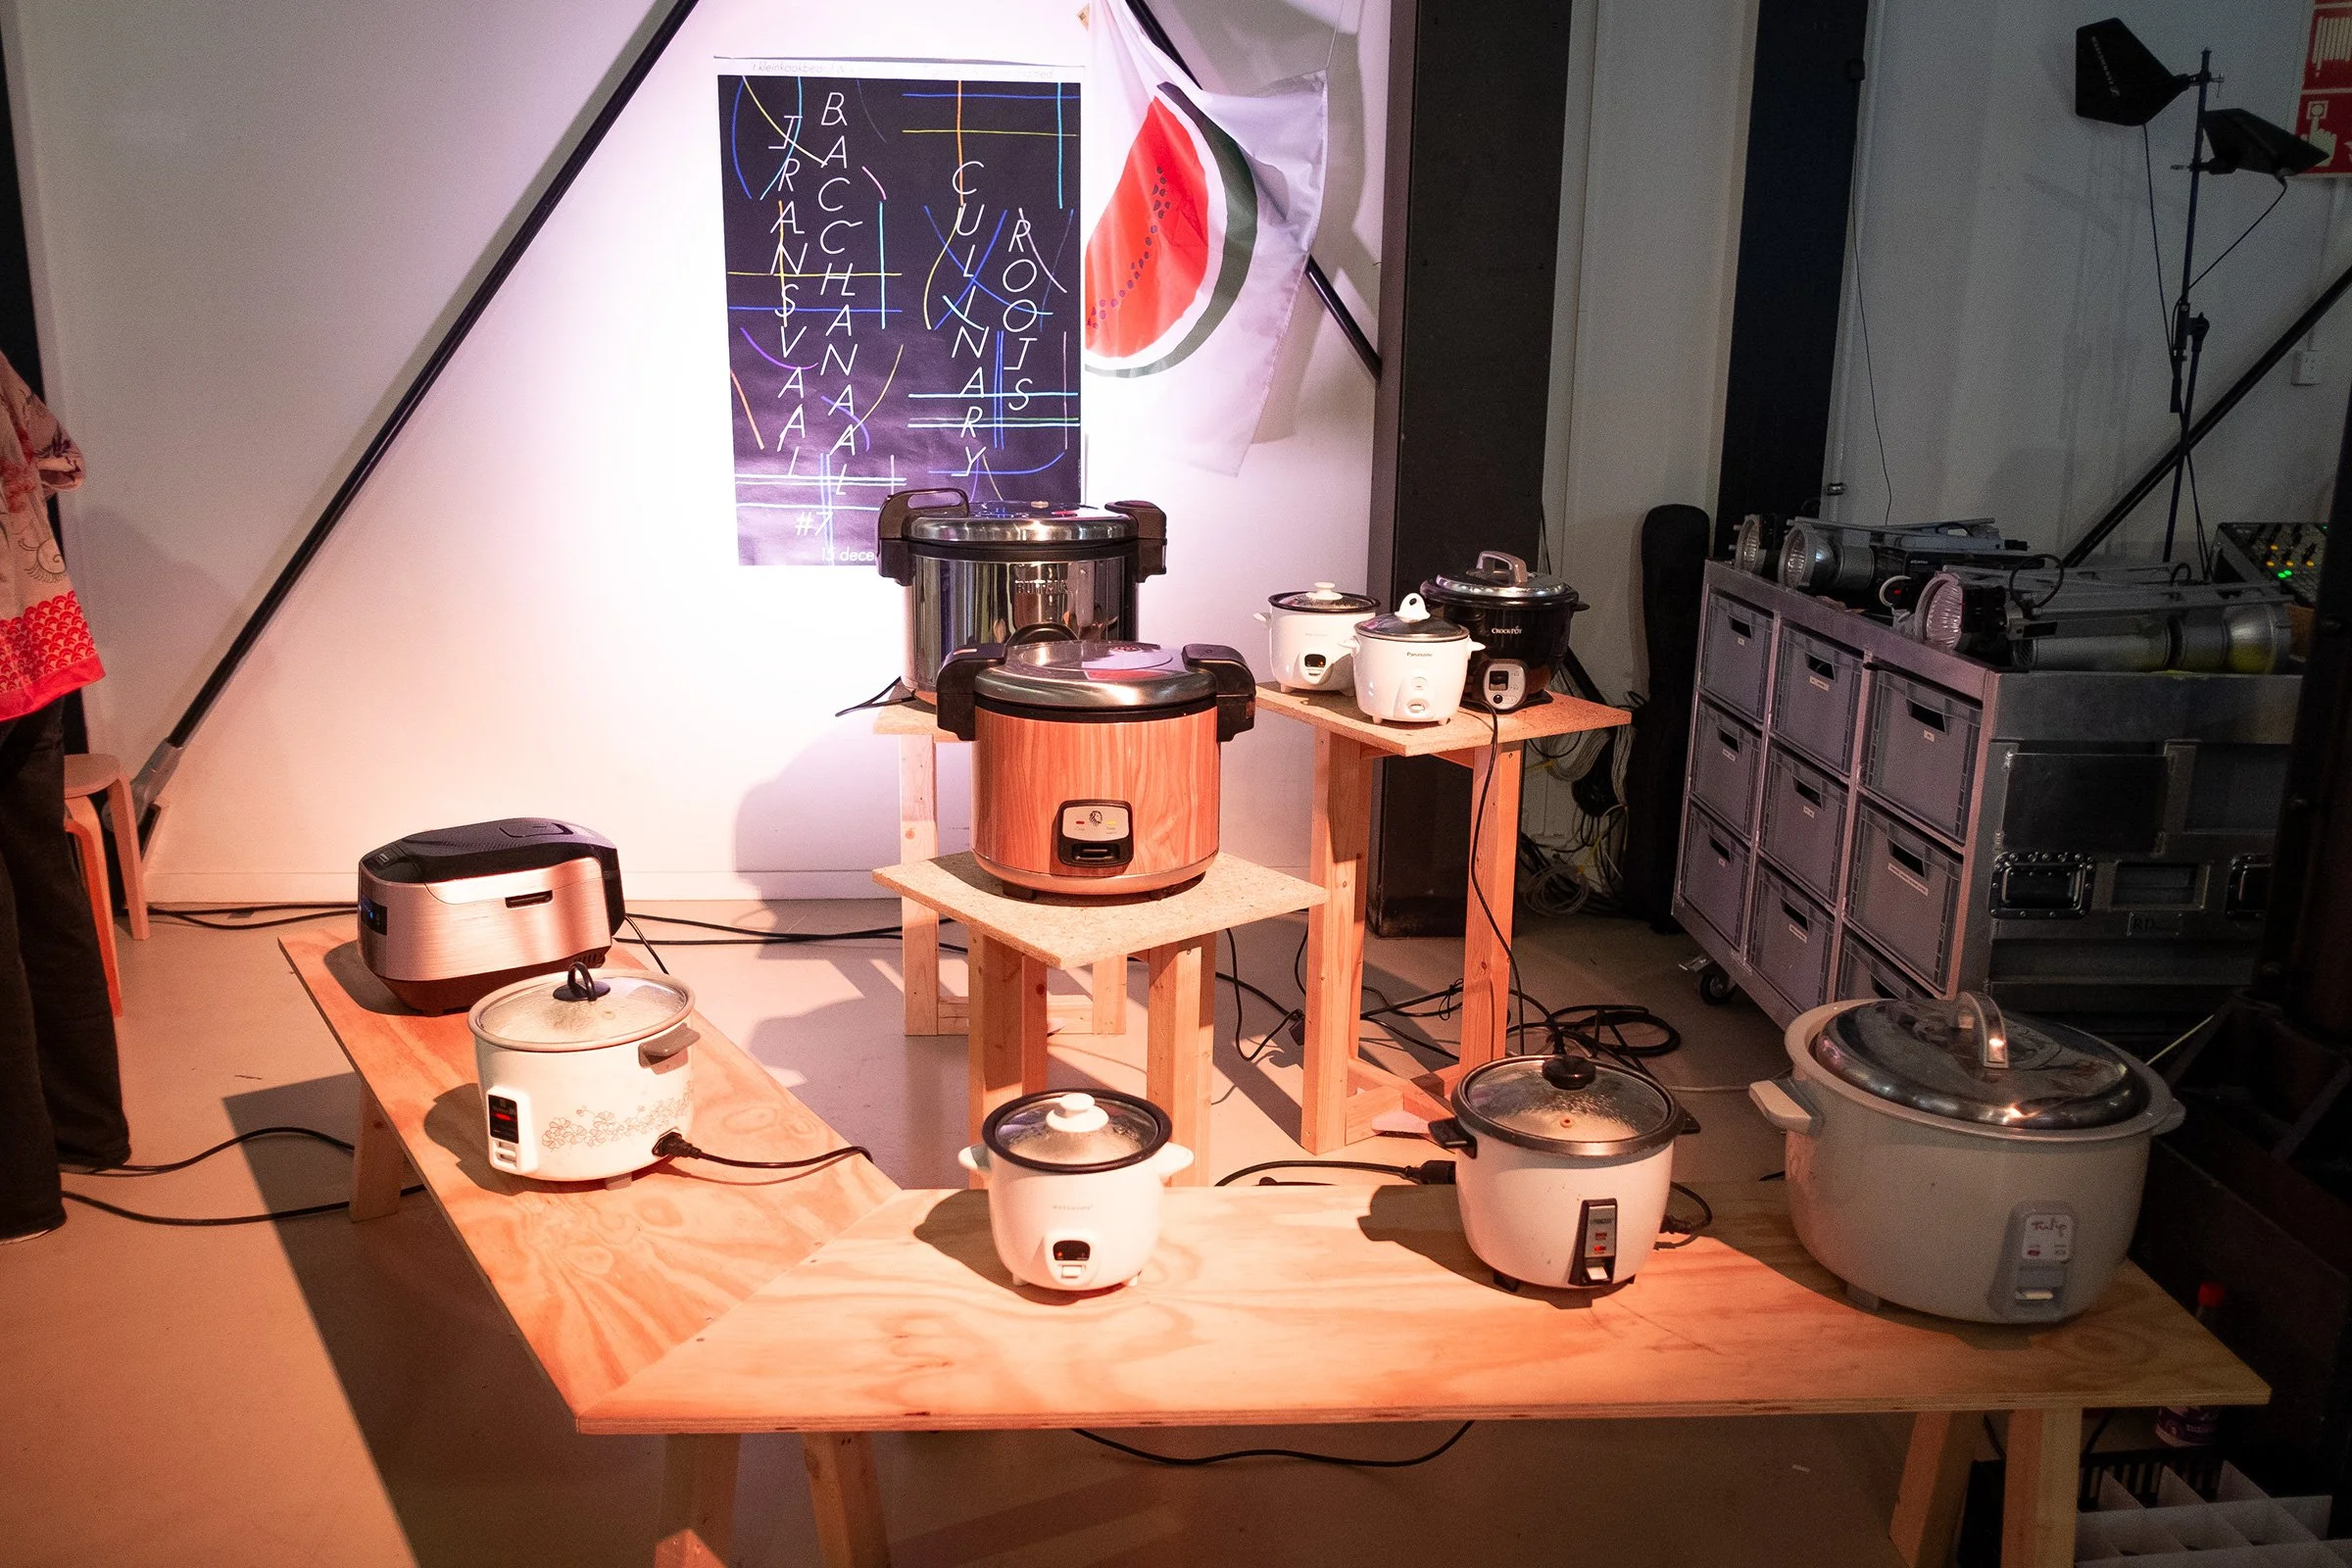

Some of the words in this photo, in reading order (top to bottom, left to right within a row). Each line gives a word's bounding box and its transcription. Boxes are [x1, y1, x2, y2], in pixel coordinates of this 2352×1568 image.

[818, 92, 862, 496] BACCHANAAL
[952, 161, 989, 476] CULINARY
[1003, 218, 1038, 411] ROOTS
[795, 511, 834, 536] #7
